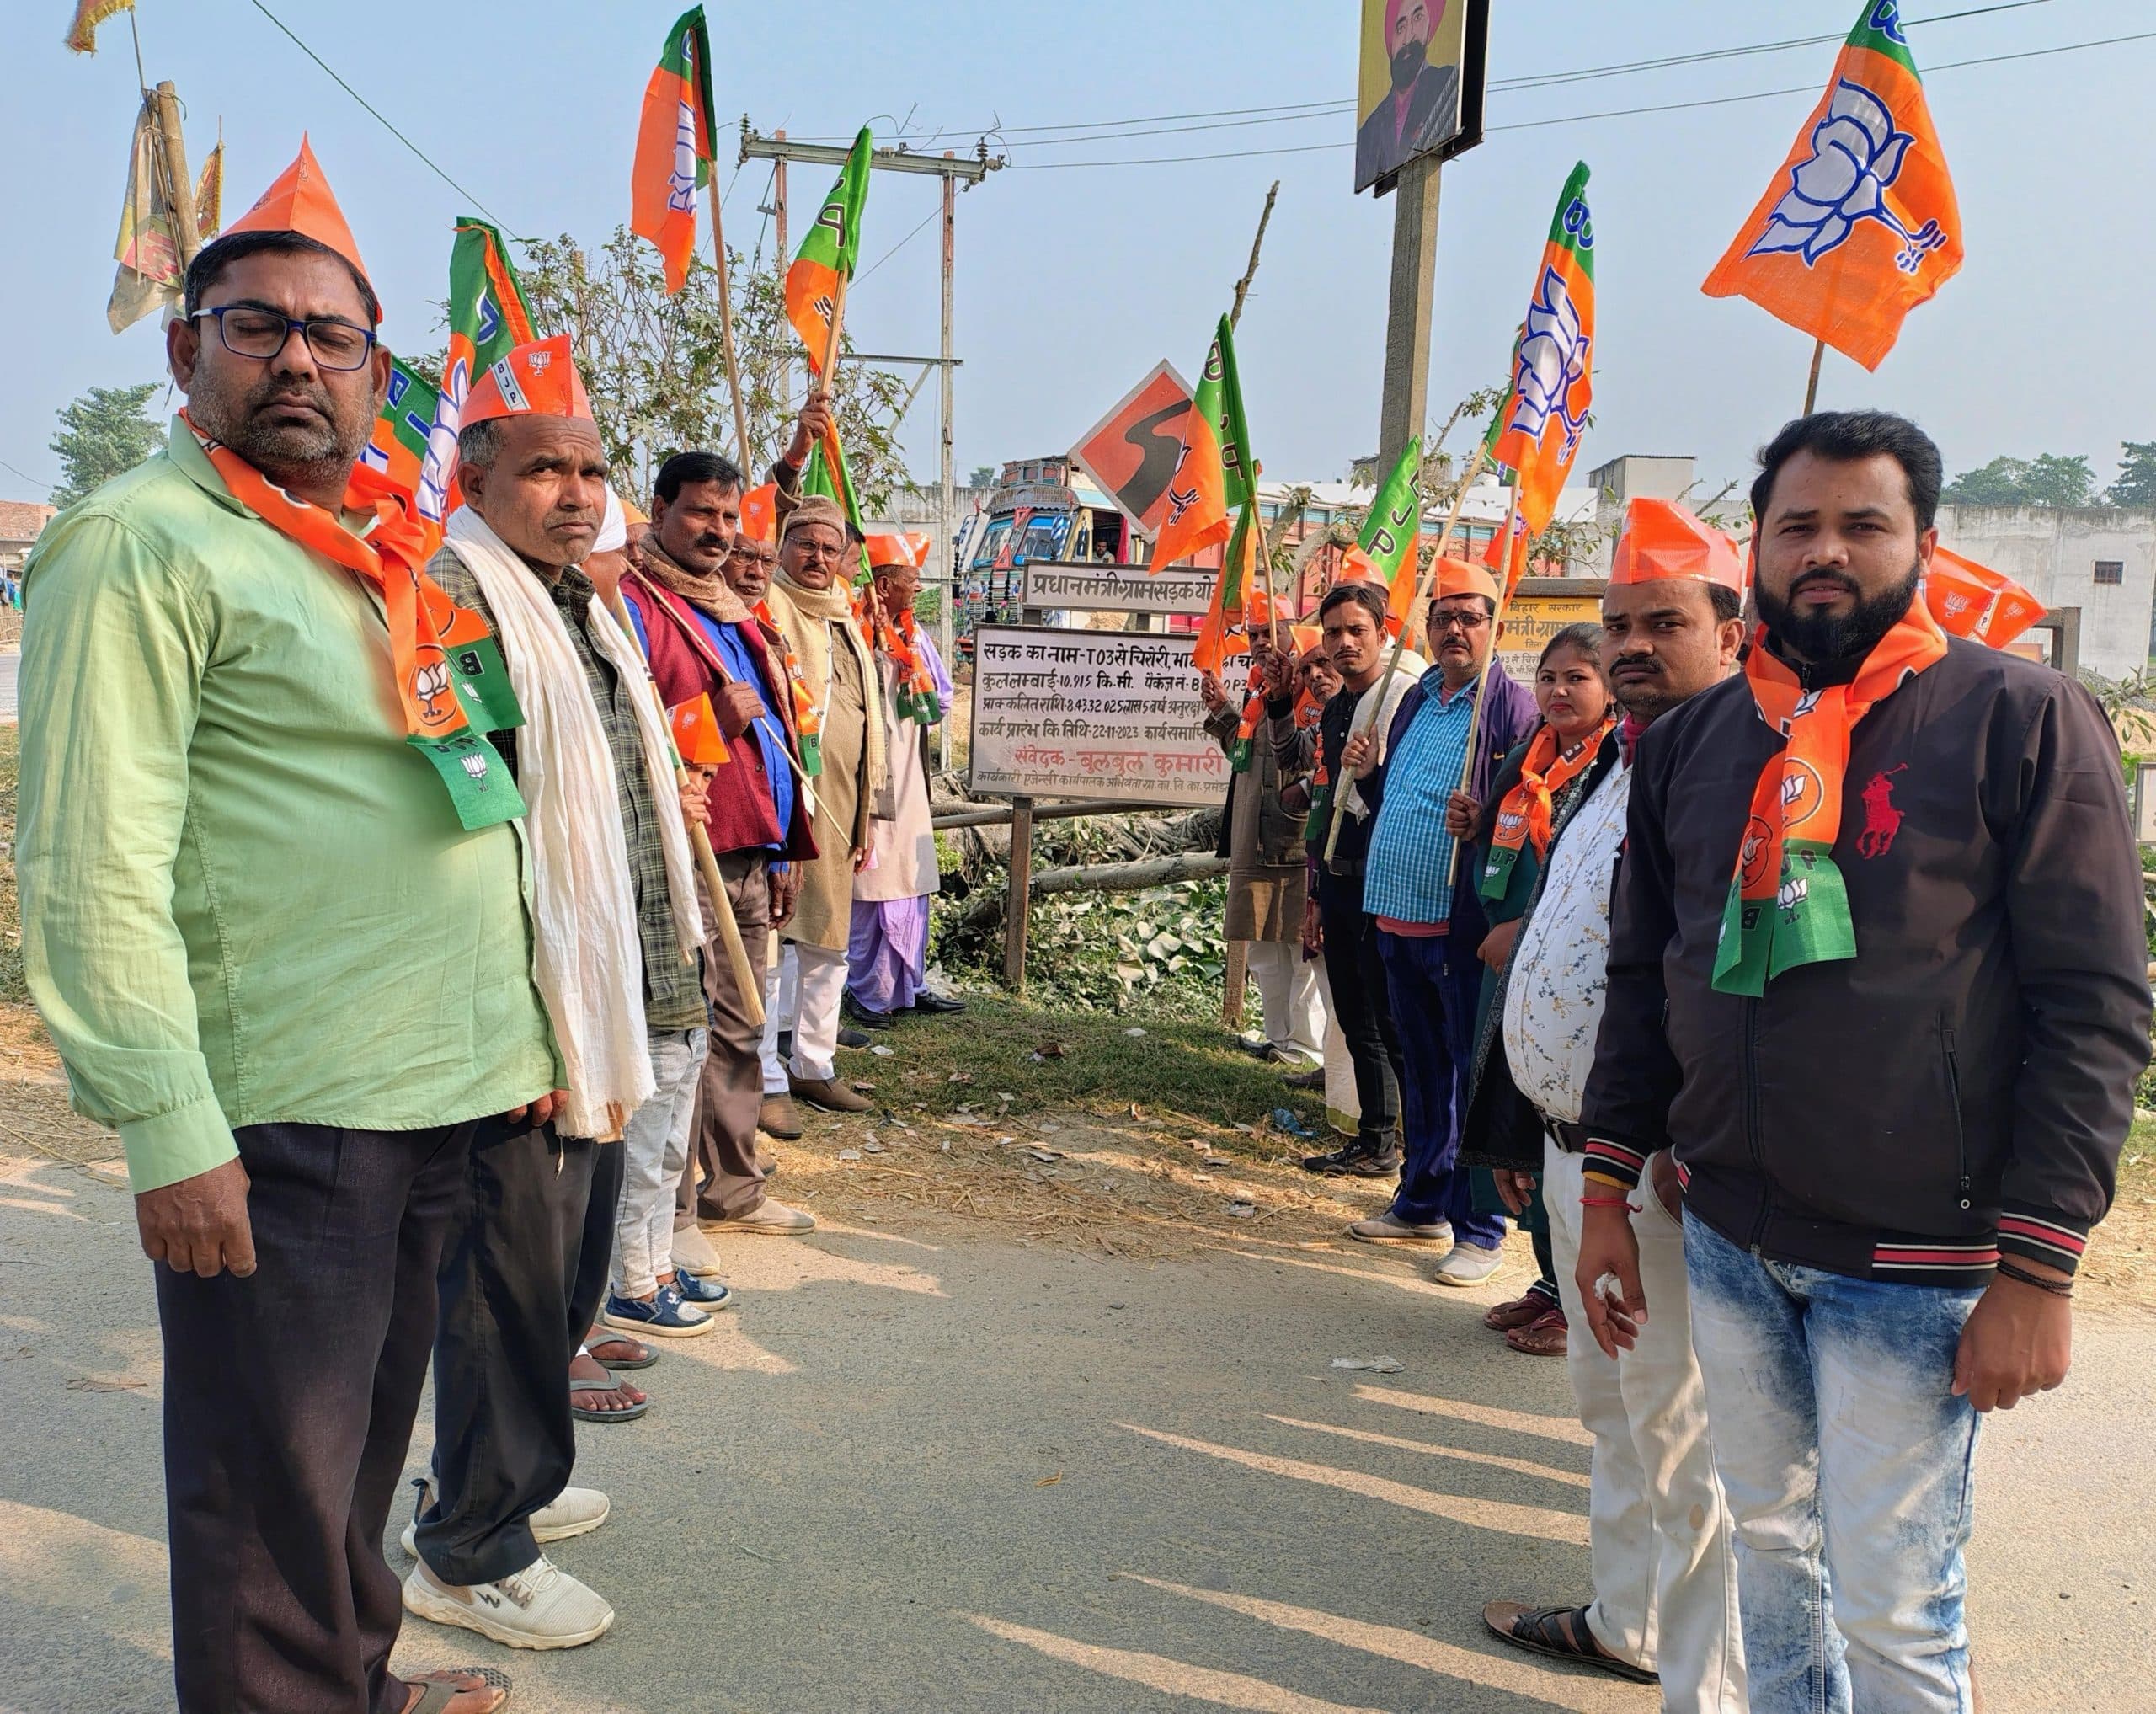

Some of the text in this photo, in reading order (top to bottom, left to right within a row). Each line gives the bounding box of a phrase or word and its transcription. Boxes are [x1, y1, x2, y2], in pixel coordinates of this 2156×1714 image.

[496, 363, 518, 404] BJP
[1548, 603, 1584, 613] सरकार
[984, 643, 1022, 662] सड़क
[1026, 645, 1047, 661] का
[979, 716, 1006, 736] कार्य
[1152, 747, 1225, 777] कुमारी
[1491, 849, 1518, 866] JP
